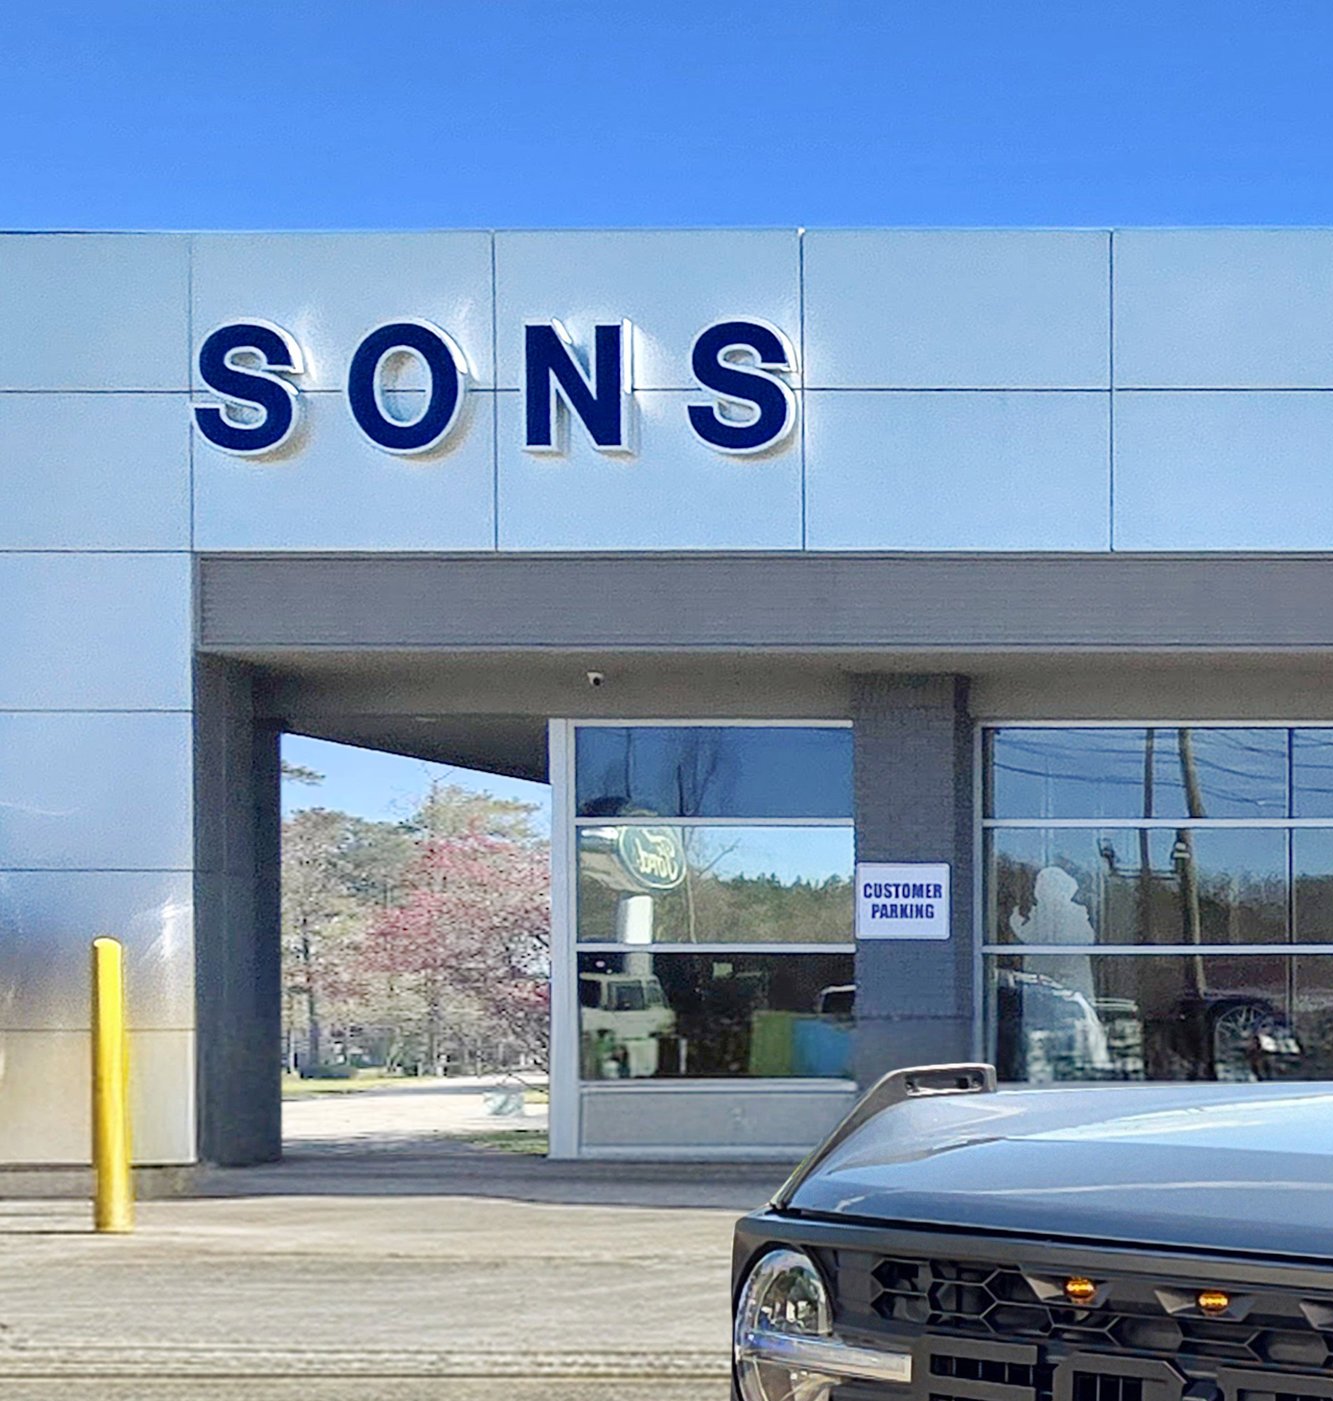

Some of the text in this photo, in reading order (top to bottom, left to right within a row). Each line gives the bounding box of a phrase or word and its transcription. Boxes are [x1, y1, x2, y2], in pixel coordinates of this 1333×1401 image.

[193, 319, 795, 455] SONS
[863, 883, 942, 899] CUSTOMER
[871, 904, 934, 919] PARKING
